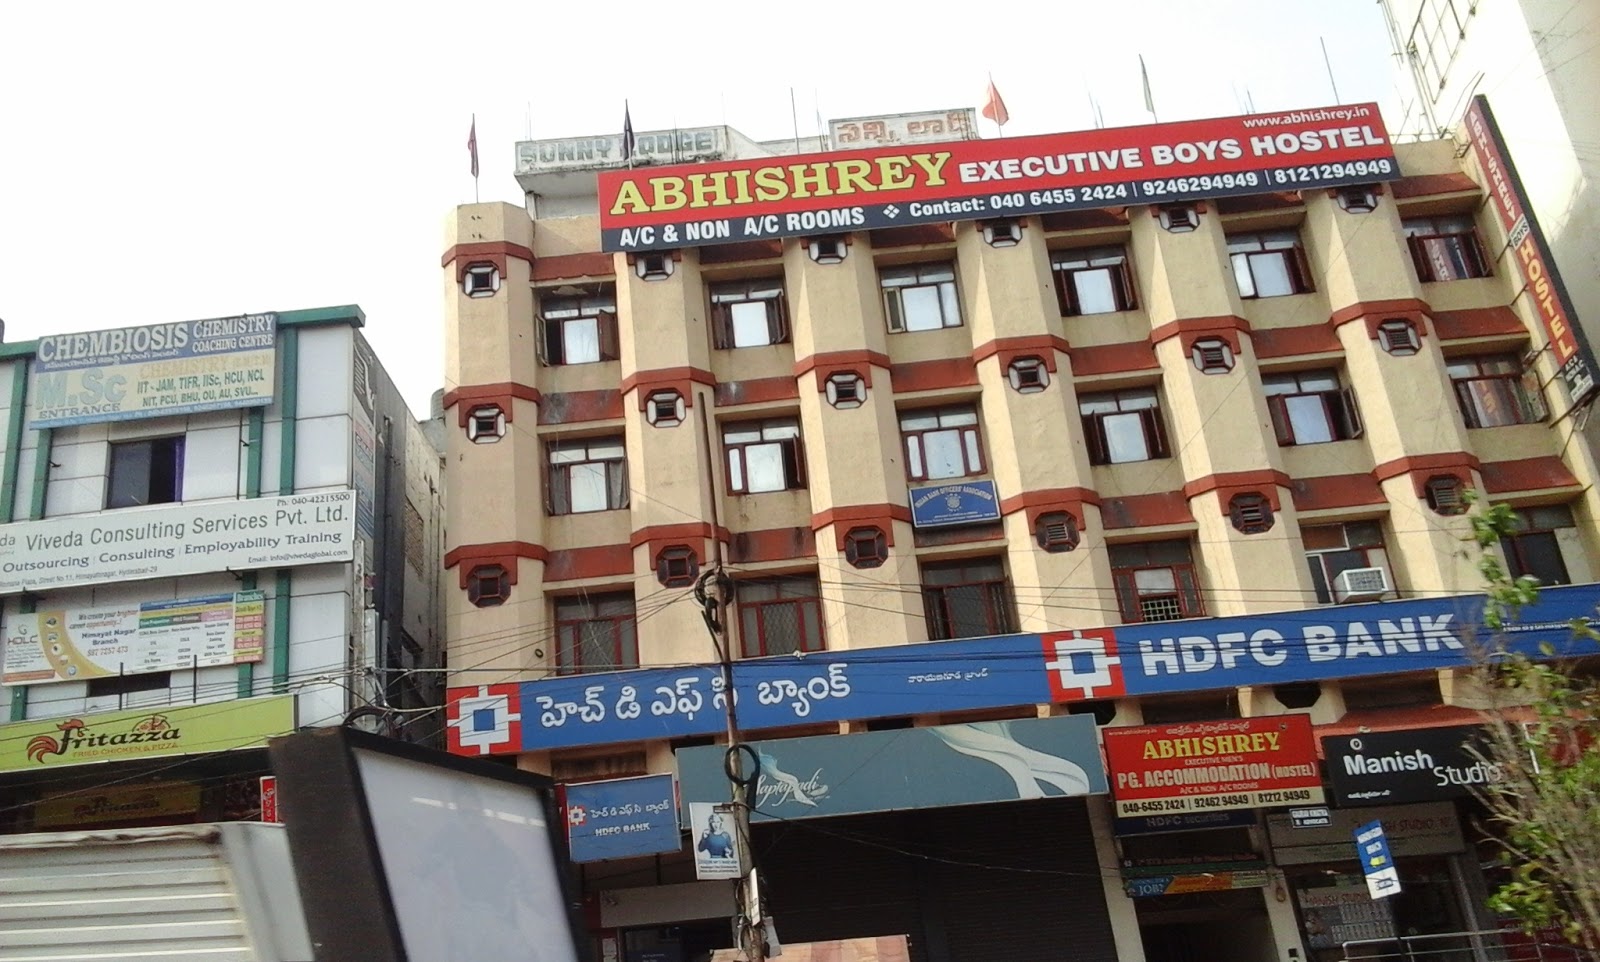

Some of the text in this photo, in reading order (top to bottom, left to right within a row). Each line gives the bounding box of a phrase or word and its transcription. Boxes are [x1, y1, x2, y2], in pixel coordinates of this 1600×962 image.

[1243, 105, 1370, 129] www.abhishrey.in
[519, 138, 611, 163] SUNNY
[610, 126, 1385, 215] ABHISHREY EXECUTIVE BOYS HOSTEL
[619, 159, 1392, 247] A/C & NON A/C ROOMS Contact: 040 6455 2424 9246294949 8121294949
[1520, 239, 1573, 359] HOSTEL
[192, 314, 274, 338] CHEMISTRY
[38, 323, 189, 363] CHEMBIOSIS
[191, 334, 274, 353] COACHING CENTRE
[35, 367, 128, 410] M.Sc
[137, 380, 150, 394] IIT
[156, 378, 176, 392] JAM,
[179, 376, 201, 390] TIFR,
[247, 369, 264, 382] NCL
[39, 402, 121, 420] ENTRANCE
[142, 396, 158, 408] NIT,
[181, 392, 200, 403] BHU,
[202, 390, 217, 401] OU,
[291, 493, 351, 506] 040-42215500
[26, 530, 83, 551] Viveda
[90, 522, 185, 545] Consulting
[191, 514, 268, 535] Services
[275, 508, 308, 527] Pvt.
[316, 504, 349, 523] Ltd.
[2, 532, 342, 573] Outsourcing Consulting Employability Training
[1137, 613, 1465, 677] HDFC BANK
[535, 685, 605, 728] హెచ్
[614, 685, 641, 720] డి
[650, 677, 703, 721] ఎఫ్
[757, 663, 852, 717] బ్యాంక్
[73, 750, 98, 758] FRIED
[100, 746, 142, 755] CHICKEN
[148, 742, 179, 751] PIZZA
[1142, 731, 1281, 760] ABHISHREY
[1184, 757, 1220, 766] EXECUTIVE
[1342, 749, 1434, 776] Manish
[1433, 761, 1502, 787] Studio
[1116, 761, 1317, 790] PG. ACCOMMODATION (HOSTEL)
[1200, 784, 1217, 793] NON
[1233, 782, 1258, 791] ROOMS
[1122, 800, 1163, 813] 040-6455
[1164, 798, 1185, 811] 2424
[1194, 797, 1221, 808] 92462
[1258, 792, 1282, 803] 81212
[595, 822, 651, 837] HDFC BANK
[1146, 815, 1182, 827] HDFC
